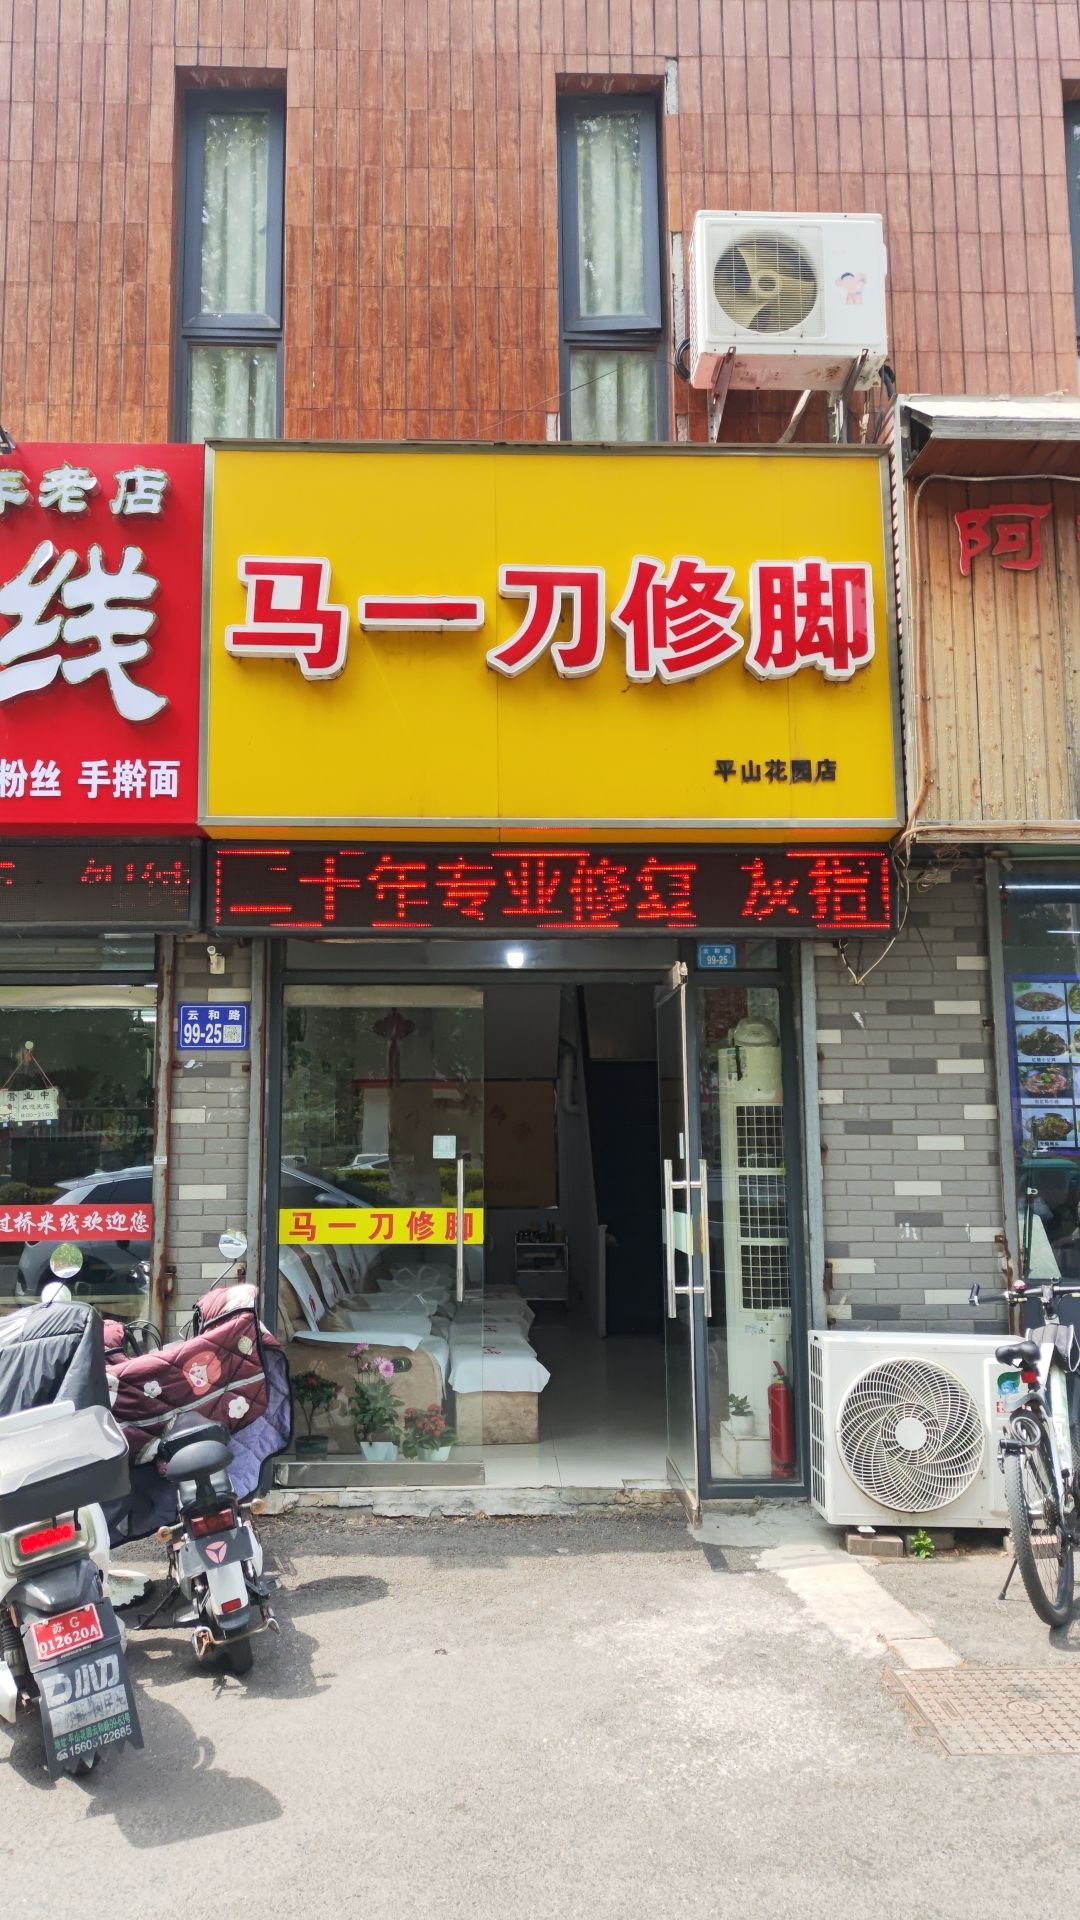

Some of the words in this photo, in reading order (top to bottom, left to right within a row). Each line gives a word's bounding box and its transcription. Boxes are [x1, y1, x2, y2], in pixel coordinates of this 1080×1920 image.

[224, 554, 875, 682] 马一刀修脚
[0, 759, 62, 799] 粉丝
[78, 759, 181, 799] 手擀面
[713, 758, 837, 784] 平山花园店
[228, 855, 696, 922] 二十年专业修复
[187, 1009, 241, 1021] 云和路
[183, 1023, 222, 1044] 99-25
[7, 1090, 50, 1102] 营业中
[0, 1210, 149, 1236] 过桥米线欢迎您
[288, 1210, 475, 1242] 马一刀修脚
[50, 1621, 65, 1635] 苏
[69, 1616, 80, 1628] G
